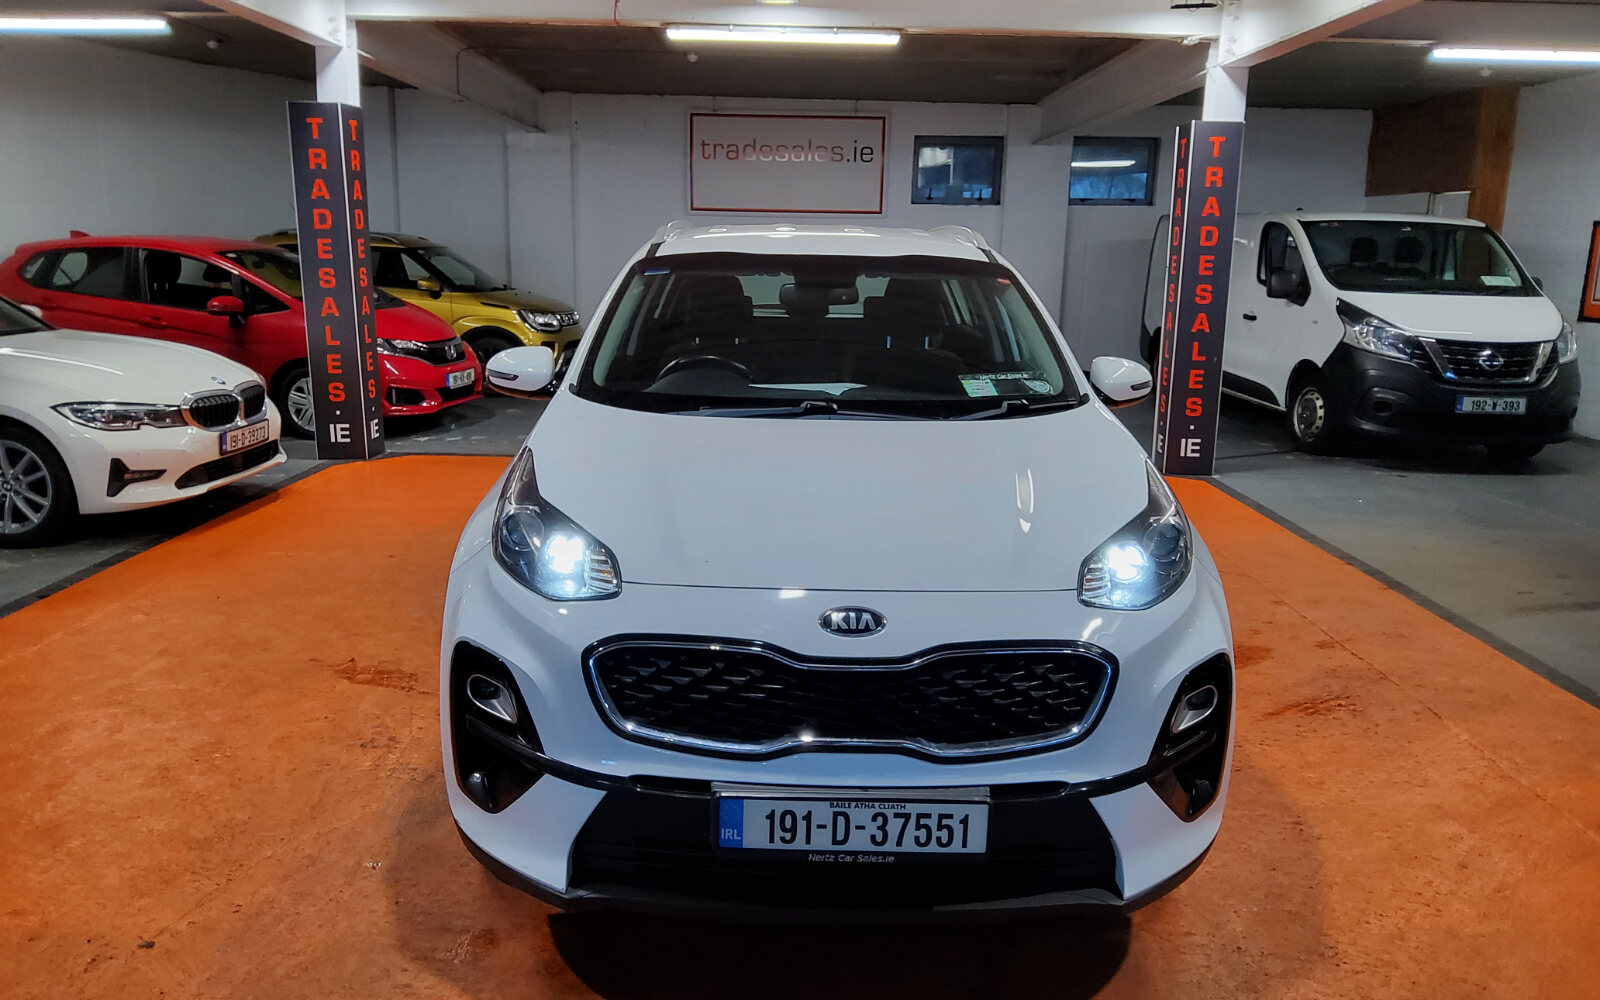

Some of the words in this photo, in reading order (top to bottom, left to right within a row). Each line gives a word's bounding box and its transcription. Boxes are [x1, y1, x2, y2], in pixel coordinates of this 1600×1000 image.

[700, 138, 874, 163] tradesales.ie
[230, 426, 266, 449] 191-D-39273
[831, 611, 876, 630] KIA
[721, 827, 741, 840] IRL
[765, 808, 969, 848] 191-D-37551
[808, 853, 835, 862] Hertz
[838, 854, 855, 862] Car
[857, 855, 895, 863] Sales.ie
